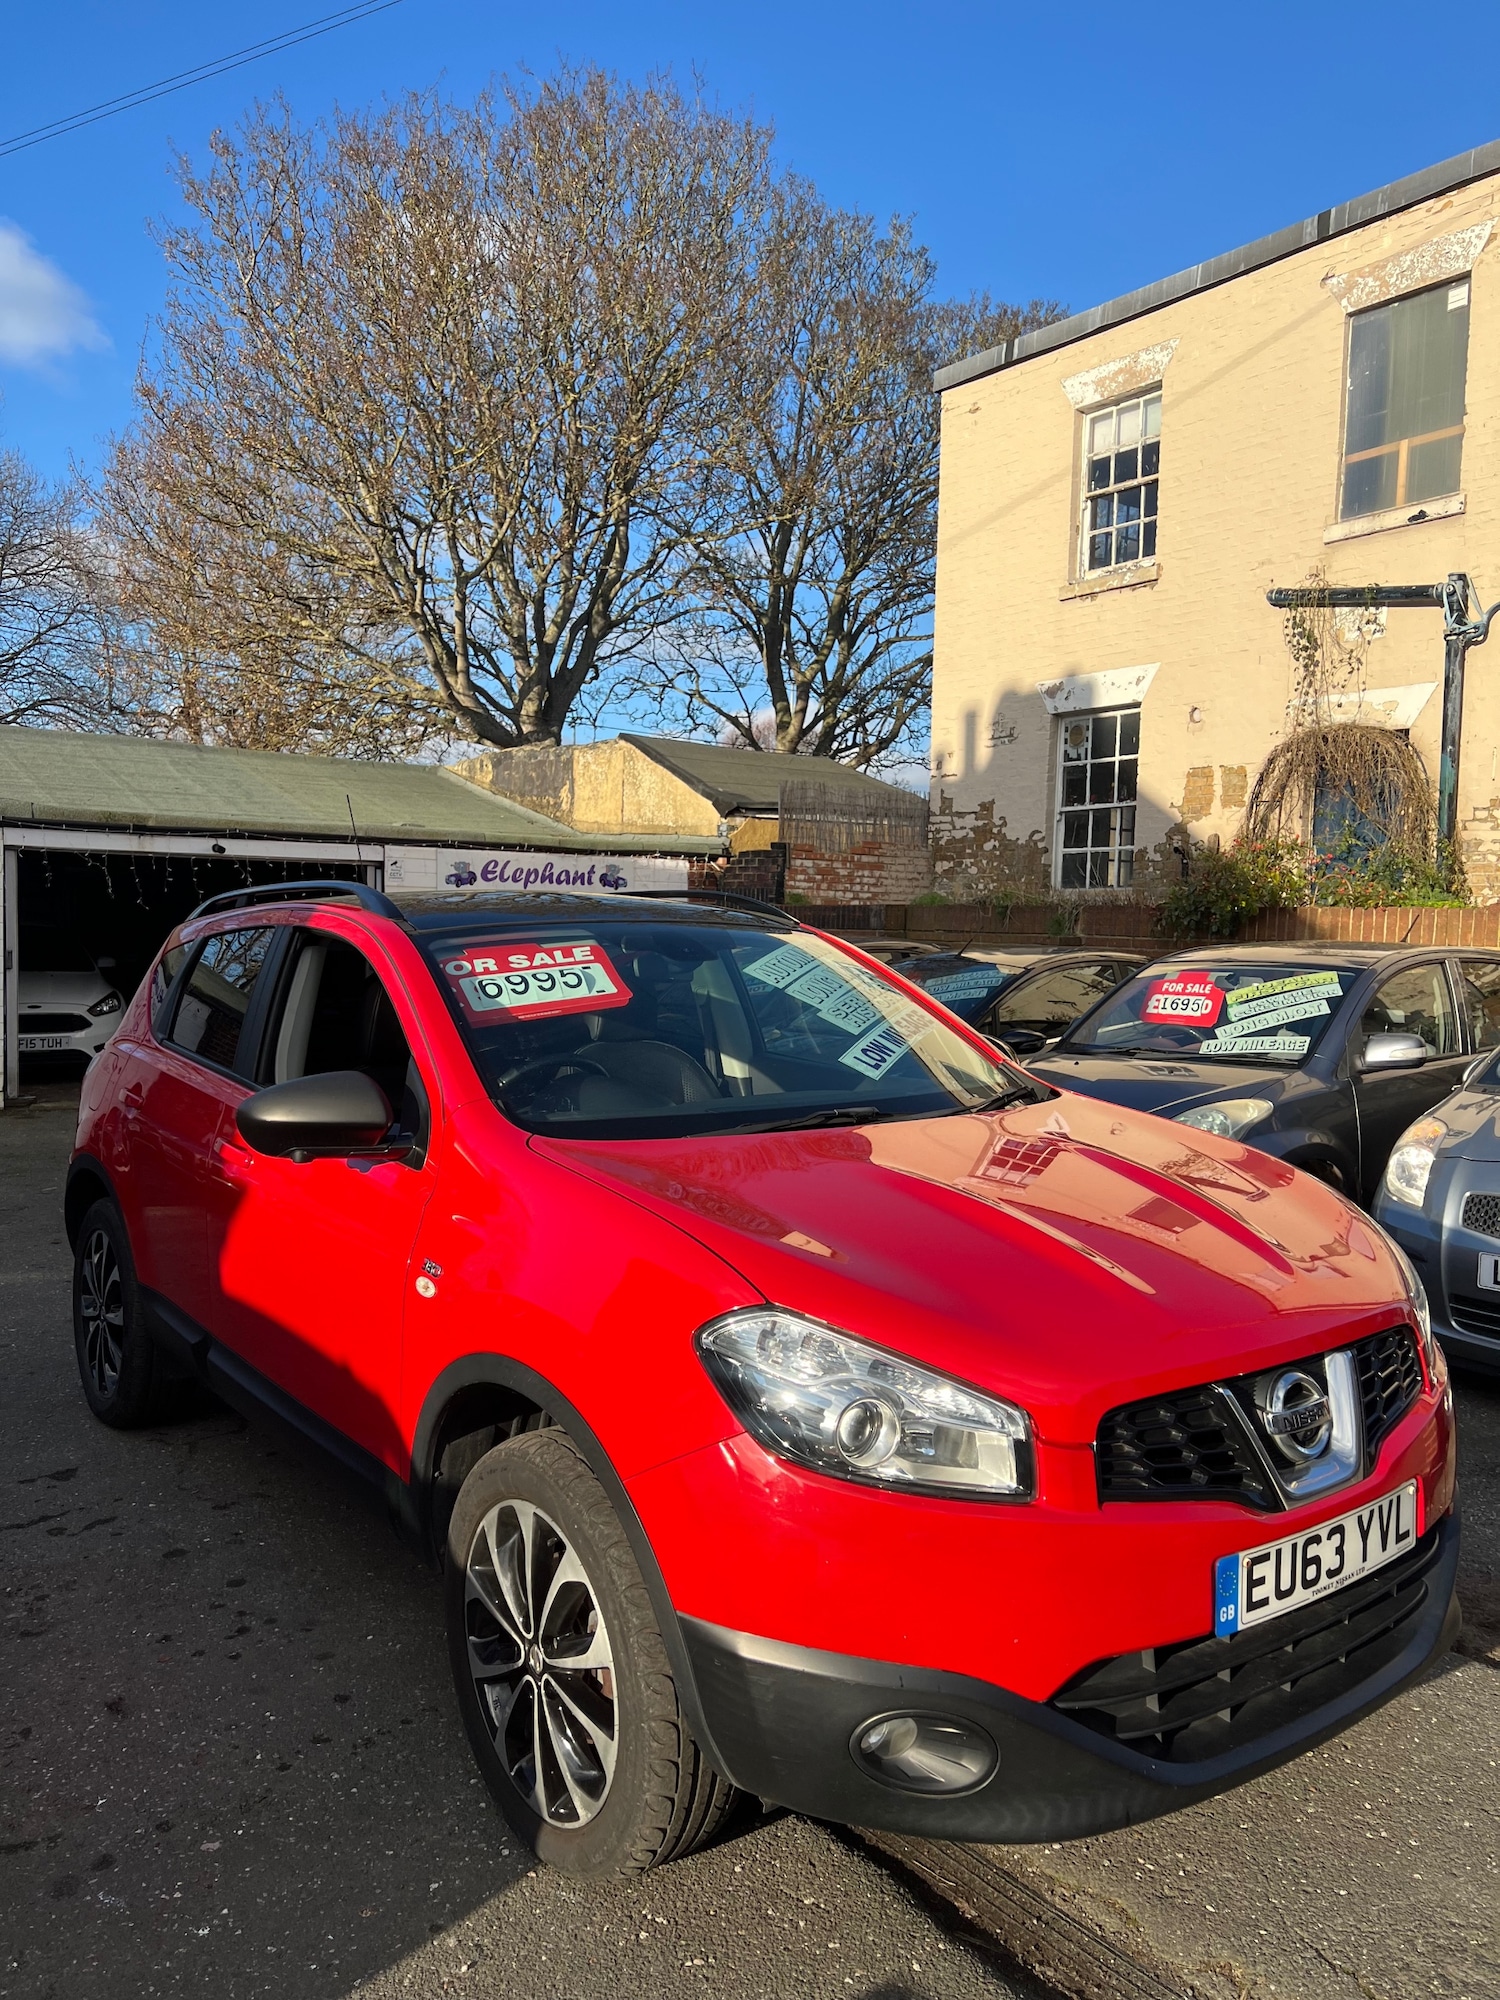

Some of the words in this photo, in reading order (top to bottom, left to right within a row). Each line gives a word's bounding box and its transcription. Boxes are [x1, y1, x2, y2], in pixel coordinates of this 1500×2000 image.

[480, 859, 596, 890] Elephant
[441, 957, 498, 976] OR
[508, 946, 594, 968] SALE
[752, 945, 823, 984] AUTOM
[478, 967, 583, 1000] 6995
[1162, 983, 1184, 993] FOR
[1185, 984, 1213, 994] SALE
[1220, 1015, 1269, 1038] LONG
[1273, 1003, 1322, 1023] M.O.T
[18, 1039, 36, 1049] F15
[40, 1039, 62, 1048] TUH
[853, 1038, 896, 1070] LOW
[877, 1009, 935, 1049] MILEAGE
[1203, 1041, 1236, 1053] LOW
[1240, 1039, 1307, 1051] MILEAGE
[1246, 1524, 1345, 1613] EU63
[1358, 1494, 1410, 1563] YVL
[1220, 1604, 1235, 1624] GB
